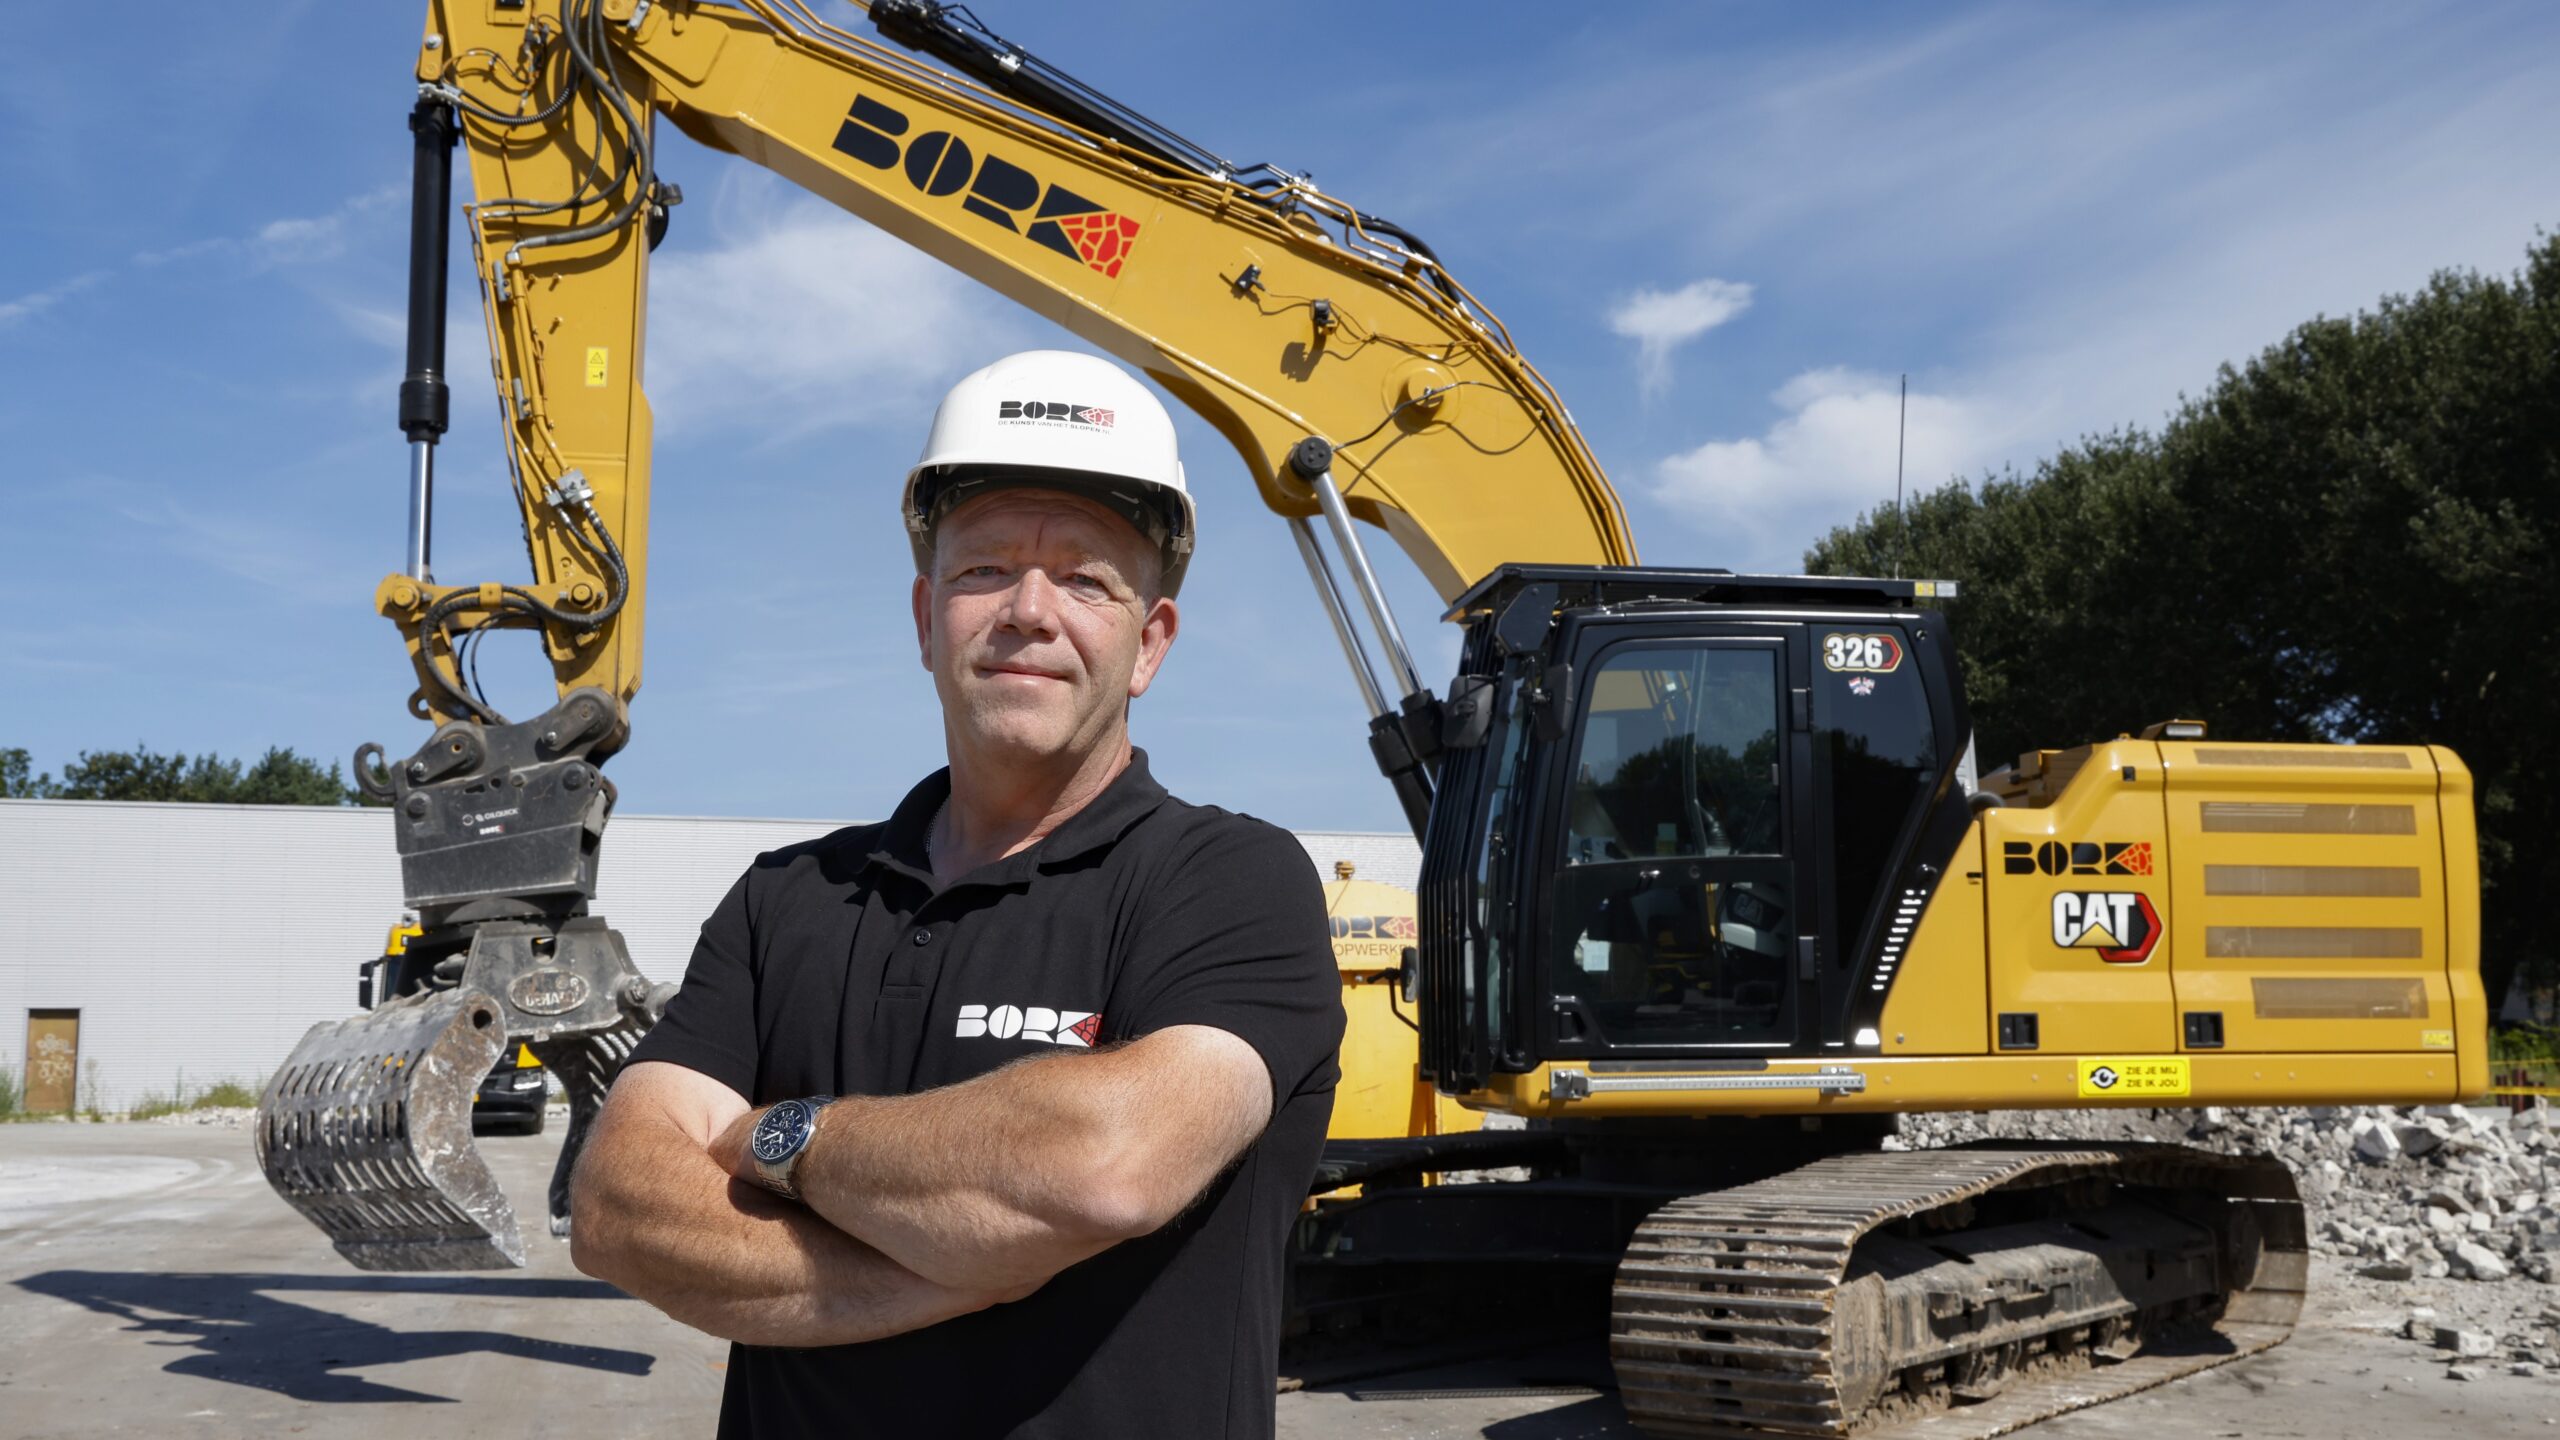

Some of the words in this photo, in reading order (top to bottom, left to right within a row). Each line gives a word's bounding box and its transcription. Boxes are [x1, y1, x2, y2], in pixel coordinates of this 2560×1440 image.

[832, 93, 1141, 279] BORK
[999, 400, 1115, 427] BORK
[1826, 636, 1883, 668] 326
[2003, 840, 2153, 876] BORK
[1329, 916, 1417, 939] ORK
[2053, 891, 2136, 948] CAT
[956, 1004, 1102, 1048] BORK
[2126, 1066, 2142, 1075] ZIE
[2145, 1066, 2156, 1075] JE
[2160, 1066, 2178, 1075] MIJ
[2126, 1079, 2142, 1088] ZIE
[2145, 1079, 2156, 1088] IK
[2159, 1079, 2179, 1088] JOU
